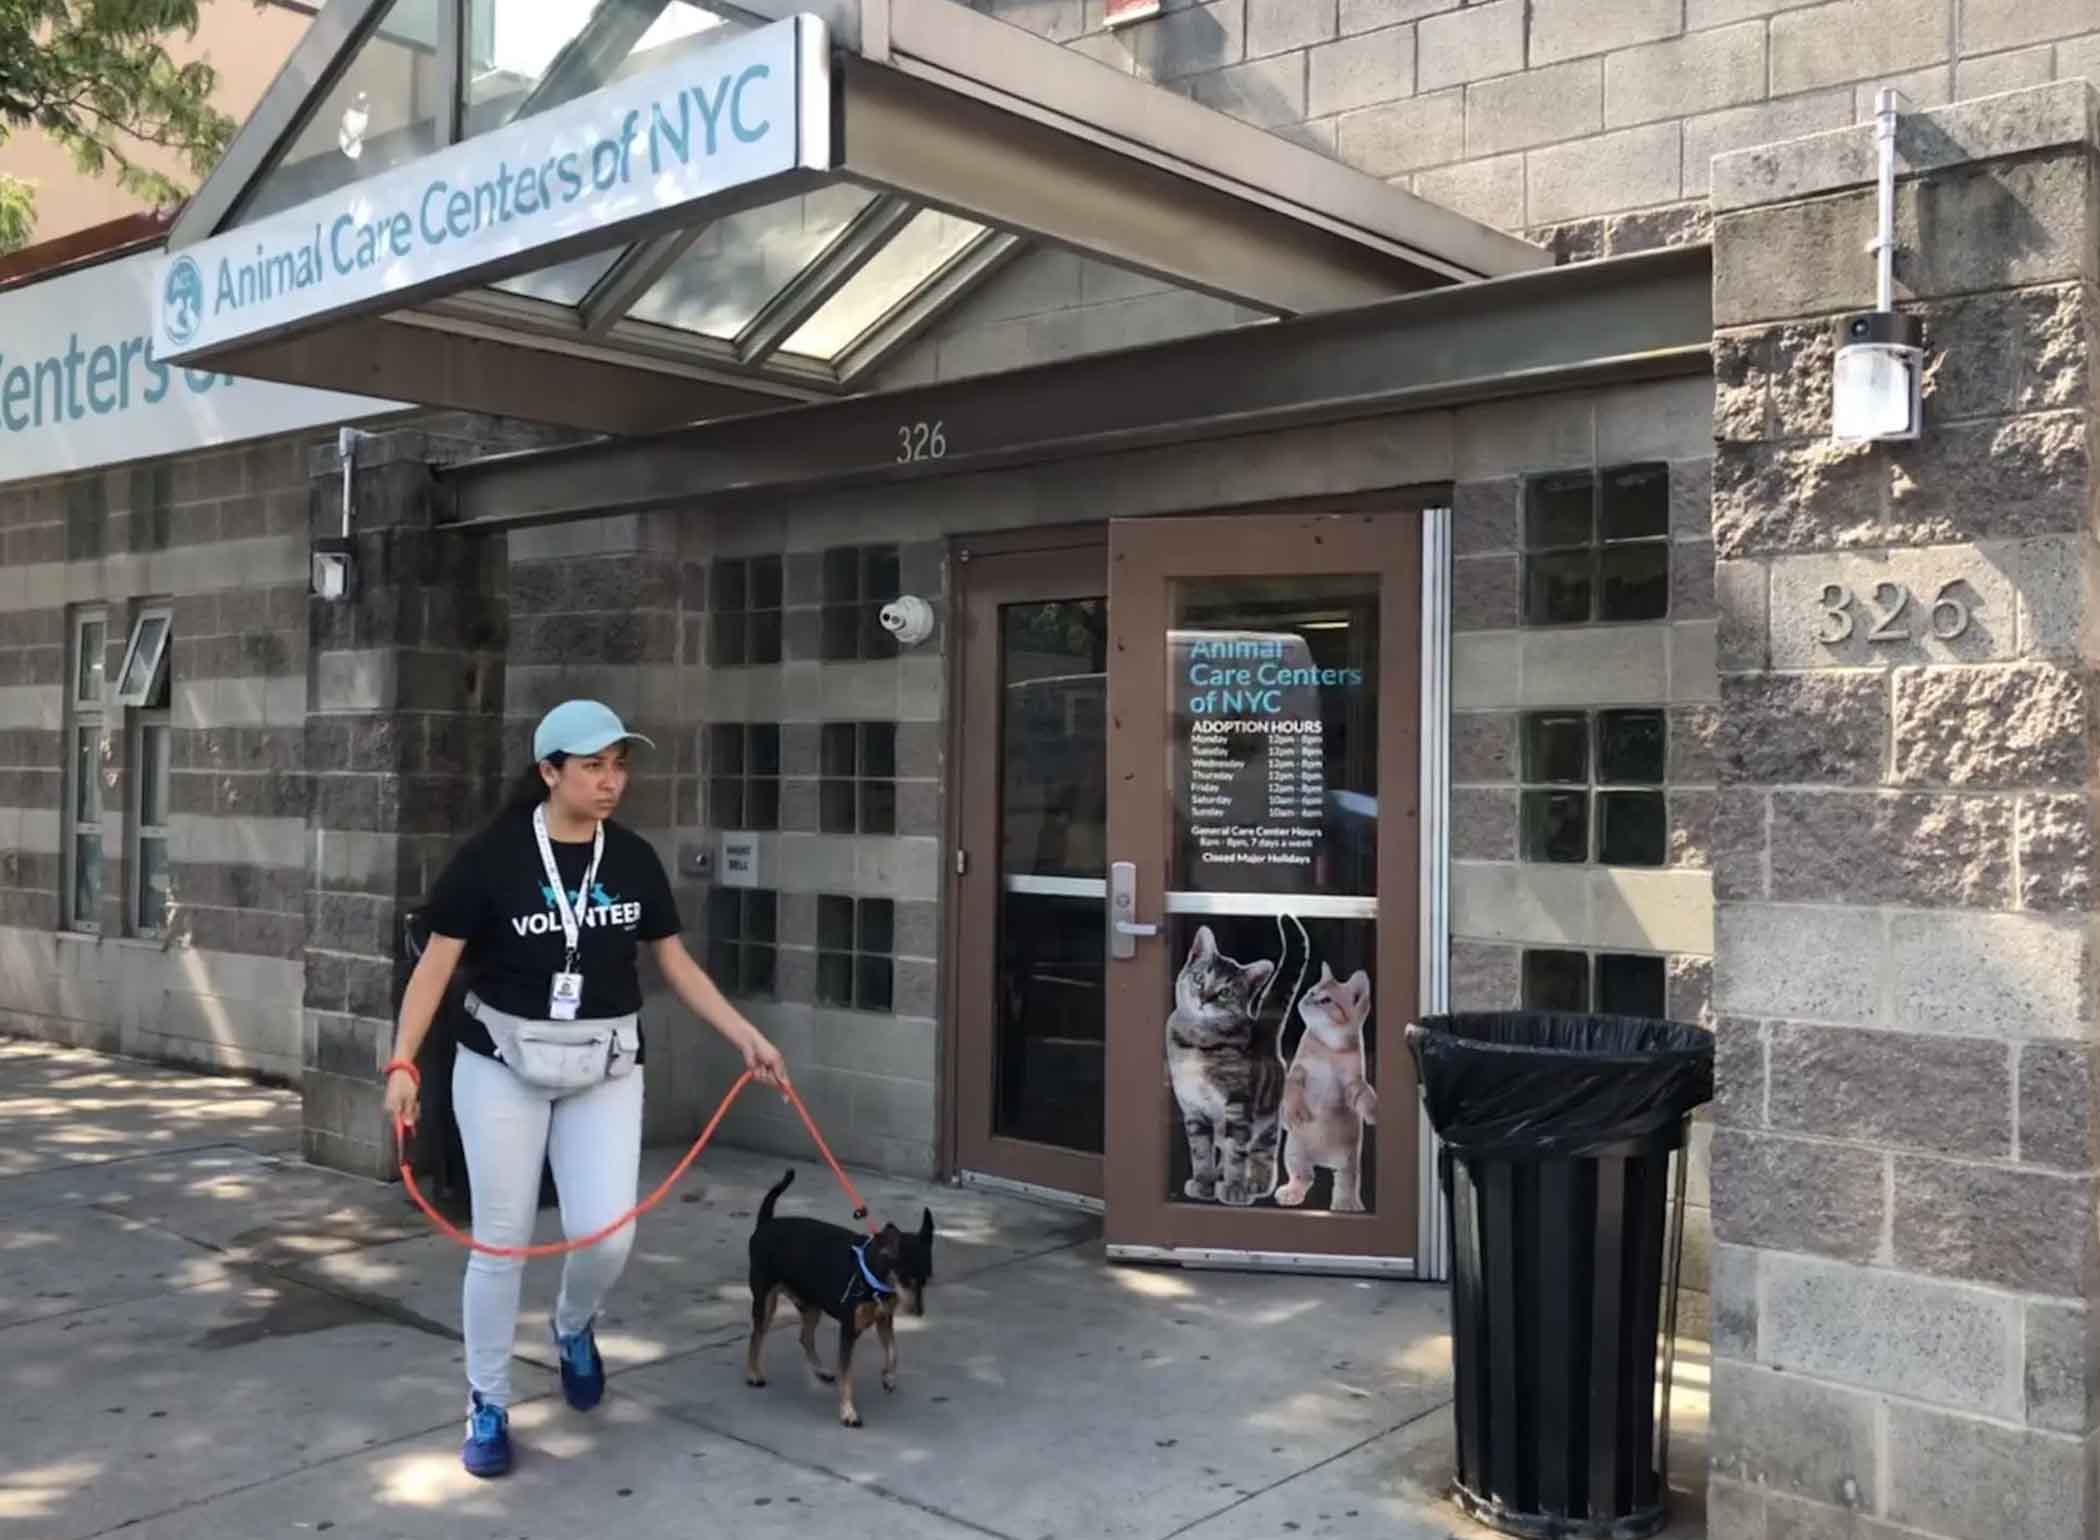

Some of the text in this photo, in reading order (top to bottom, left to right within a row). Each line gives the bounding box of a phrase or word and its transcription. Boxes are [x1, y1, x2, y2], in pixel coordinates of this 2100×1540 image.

[213, 63, 771, 315] Animal Care Centers of NYC
[0, 332, 170, 433] enters
[896, 420, 947, 465] 326
[1819, 577, 1969, 645] 326
[1191, 639, 1283, 659] Animal
[1190, 662, 1362, 686] Care Centers
[1190, 689, 1282, 713] of NYC
[1192, 720, 1322, 733] ADOPTION HOURS
[1191, 734, 1228, 744] Monday
[1192, 770, 1234, 780] Thursday
[1191, 782, 1219, 792] Friday
[1192, 795, 1232, 806] Saturday
[1192, 807, 1224, 817] Sunday
[1191, 826, 1322, 837] General Care Center Hours
[1258, 838, 1279, 848] days
[1288, 838, 1313, 847] week
[1202, 853, 1311, 864] Closed Major Holidays
[511, 902, 641, 936] VOLNTEER
